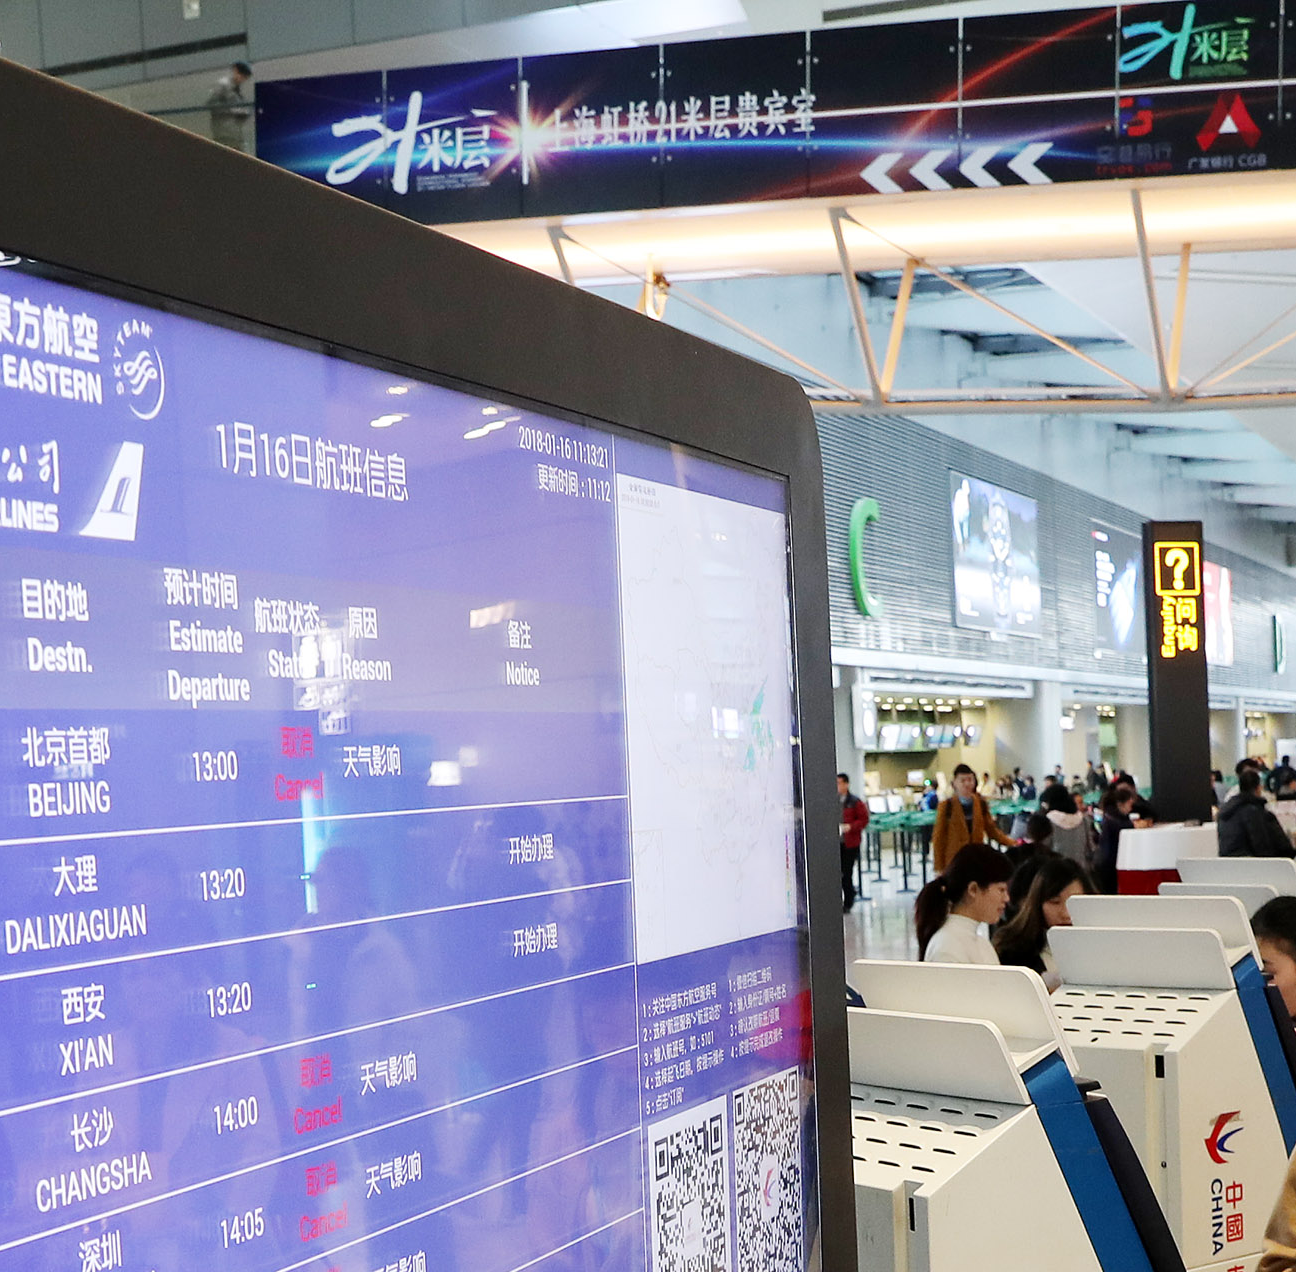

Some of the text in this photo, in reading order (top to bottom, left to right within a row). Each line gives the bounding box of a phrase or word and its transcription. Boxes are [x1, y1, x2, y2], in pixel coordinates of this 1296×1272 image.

[2, 355, 102, 404] EASTERN
[215, 422, 409, 502] 1月16日航班信息
[21, 578, 89, 622] 目的地
[163, 567, 239, 611] 预计时间
[254, 598, 320, 635] 航班状态
[348, 606, 378, 639] 原因
[507, 620, 532, 650] 备注
[1160, 595, 1176, 658] Enquiry
[1176, 597, 1198, 651] 问询
[27, 637, 93, 673] Destn.
[169, 620, 243, 654] Estimate
[268, 648, 309, 678] Stat
[342, 653, 392, 682] Reason
[506, 662, 540, 686] Notice
[167, 669, 251, 708] Departure
[21, 726, 111, 768] 北京首都
[192, 751, 238, 781] 13:00
[343, 744, 401, 777] 天气影响
[28, 781, 111, 818] BEIJING
[274, 771, 324, 801] Cancel
[508, 833, 554, 864] 开始办理
[53, 855, 98, 896] 大理
[200, 868, 245, 901] 13:20
[5, 904, 147, 954] DALIXIAGUAN
[513, 922, 558, 957] 开始办理
[61, 983, 105, 1024] 西安
[207, 981, 252, 1018] 13:20
[60, 1034, 114, 1076] XI'AN
[360, 1051, 418, 1095] 天气影响
[71, 1106, 114, 1152] 长沙
[213, 1096, 259, 1135] 14:00
[294, 1096, 343, 1134] Cancel
[36, 1151, 152, 1213] CHANGSHA
[365, 1150, 422, 1199] 天气影响
[220, 1208, 265, 1249] 14:05
[299, 1201, 348, 1243] Cancel
[1210, 1178, 1223, 1256] CHINA
